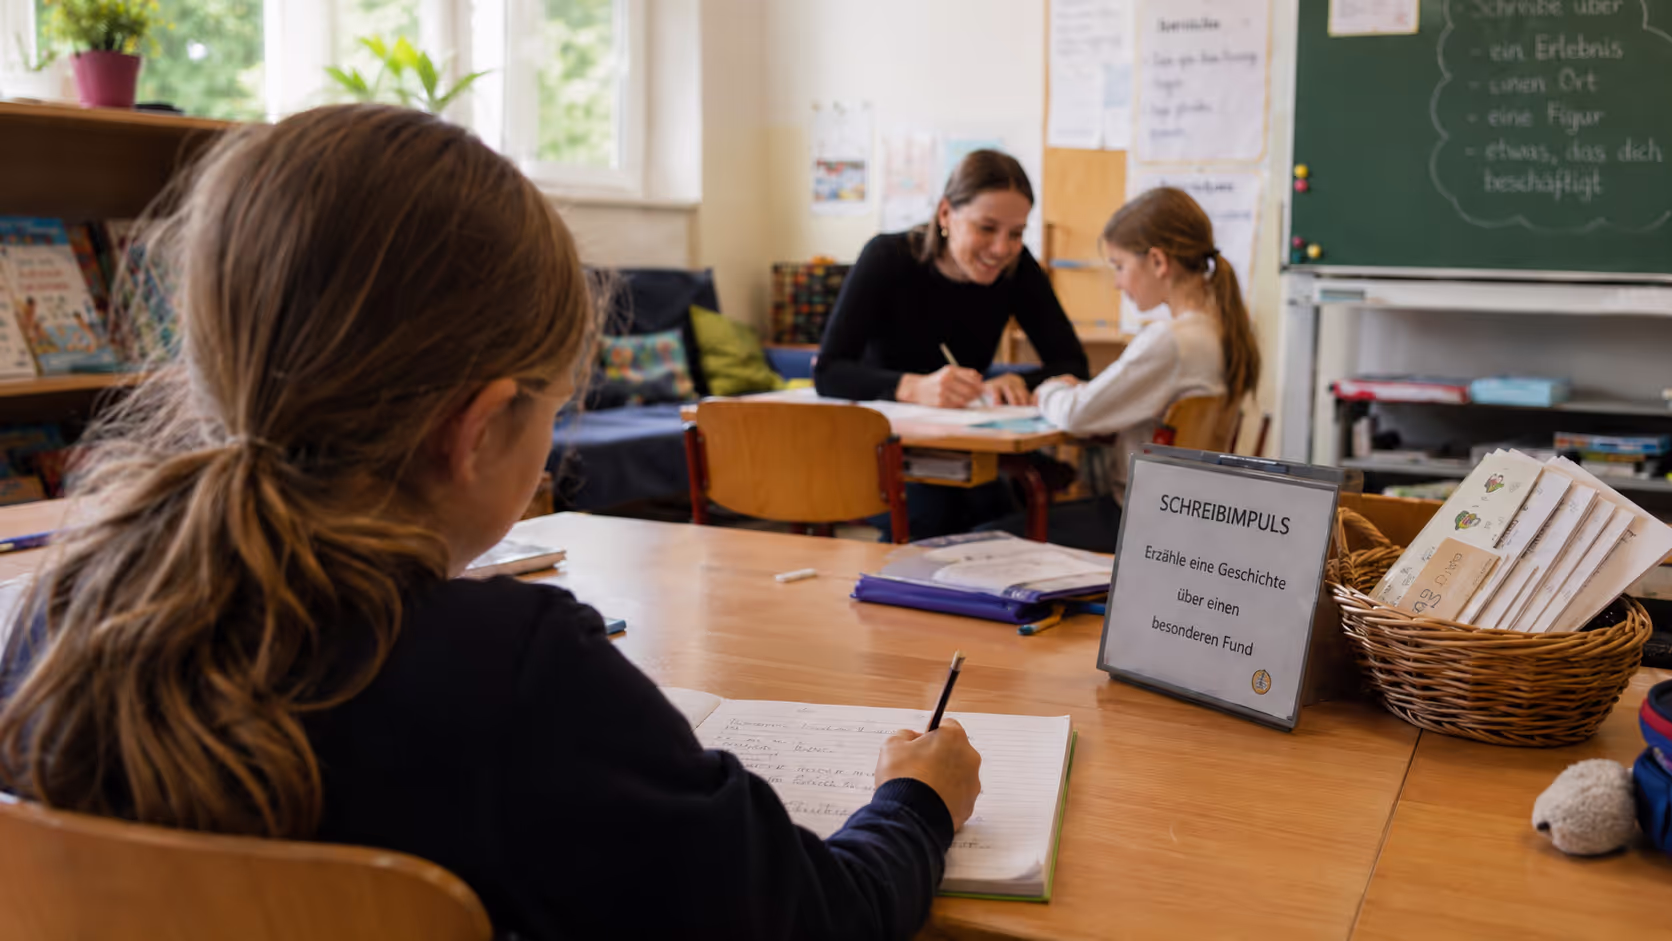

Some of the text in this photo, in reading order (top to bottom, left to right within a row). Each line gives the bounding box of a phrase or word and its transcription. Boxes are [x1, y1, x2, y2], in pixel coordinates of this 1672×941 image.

[1489, 43, 1526, 62] ein
[1535, 33, 1624, 60] Erlebnis
[1558, 66, 1598, 92] Ort
[1487, 108, 1533, 127] eine
[1547, 101, 1604, 135] Figur
[1485, 138, 1558, 165] etwas,
[1566, 139, 1607, 163] das
[1617, 137, 1663, 163] dich
[1159, 493, 1291, 536] SCHREIBIMPULS
[1144, 544, 1287, 591] Erzähle eine Geschichte
[1177, 588, 1240, 617] über einen
[1151, 615, 1254, 657] besonderen Fund
